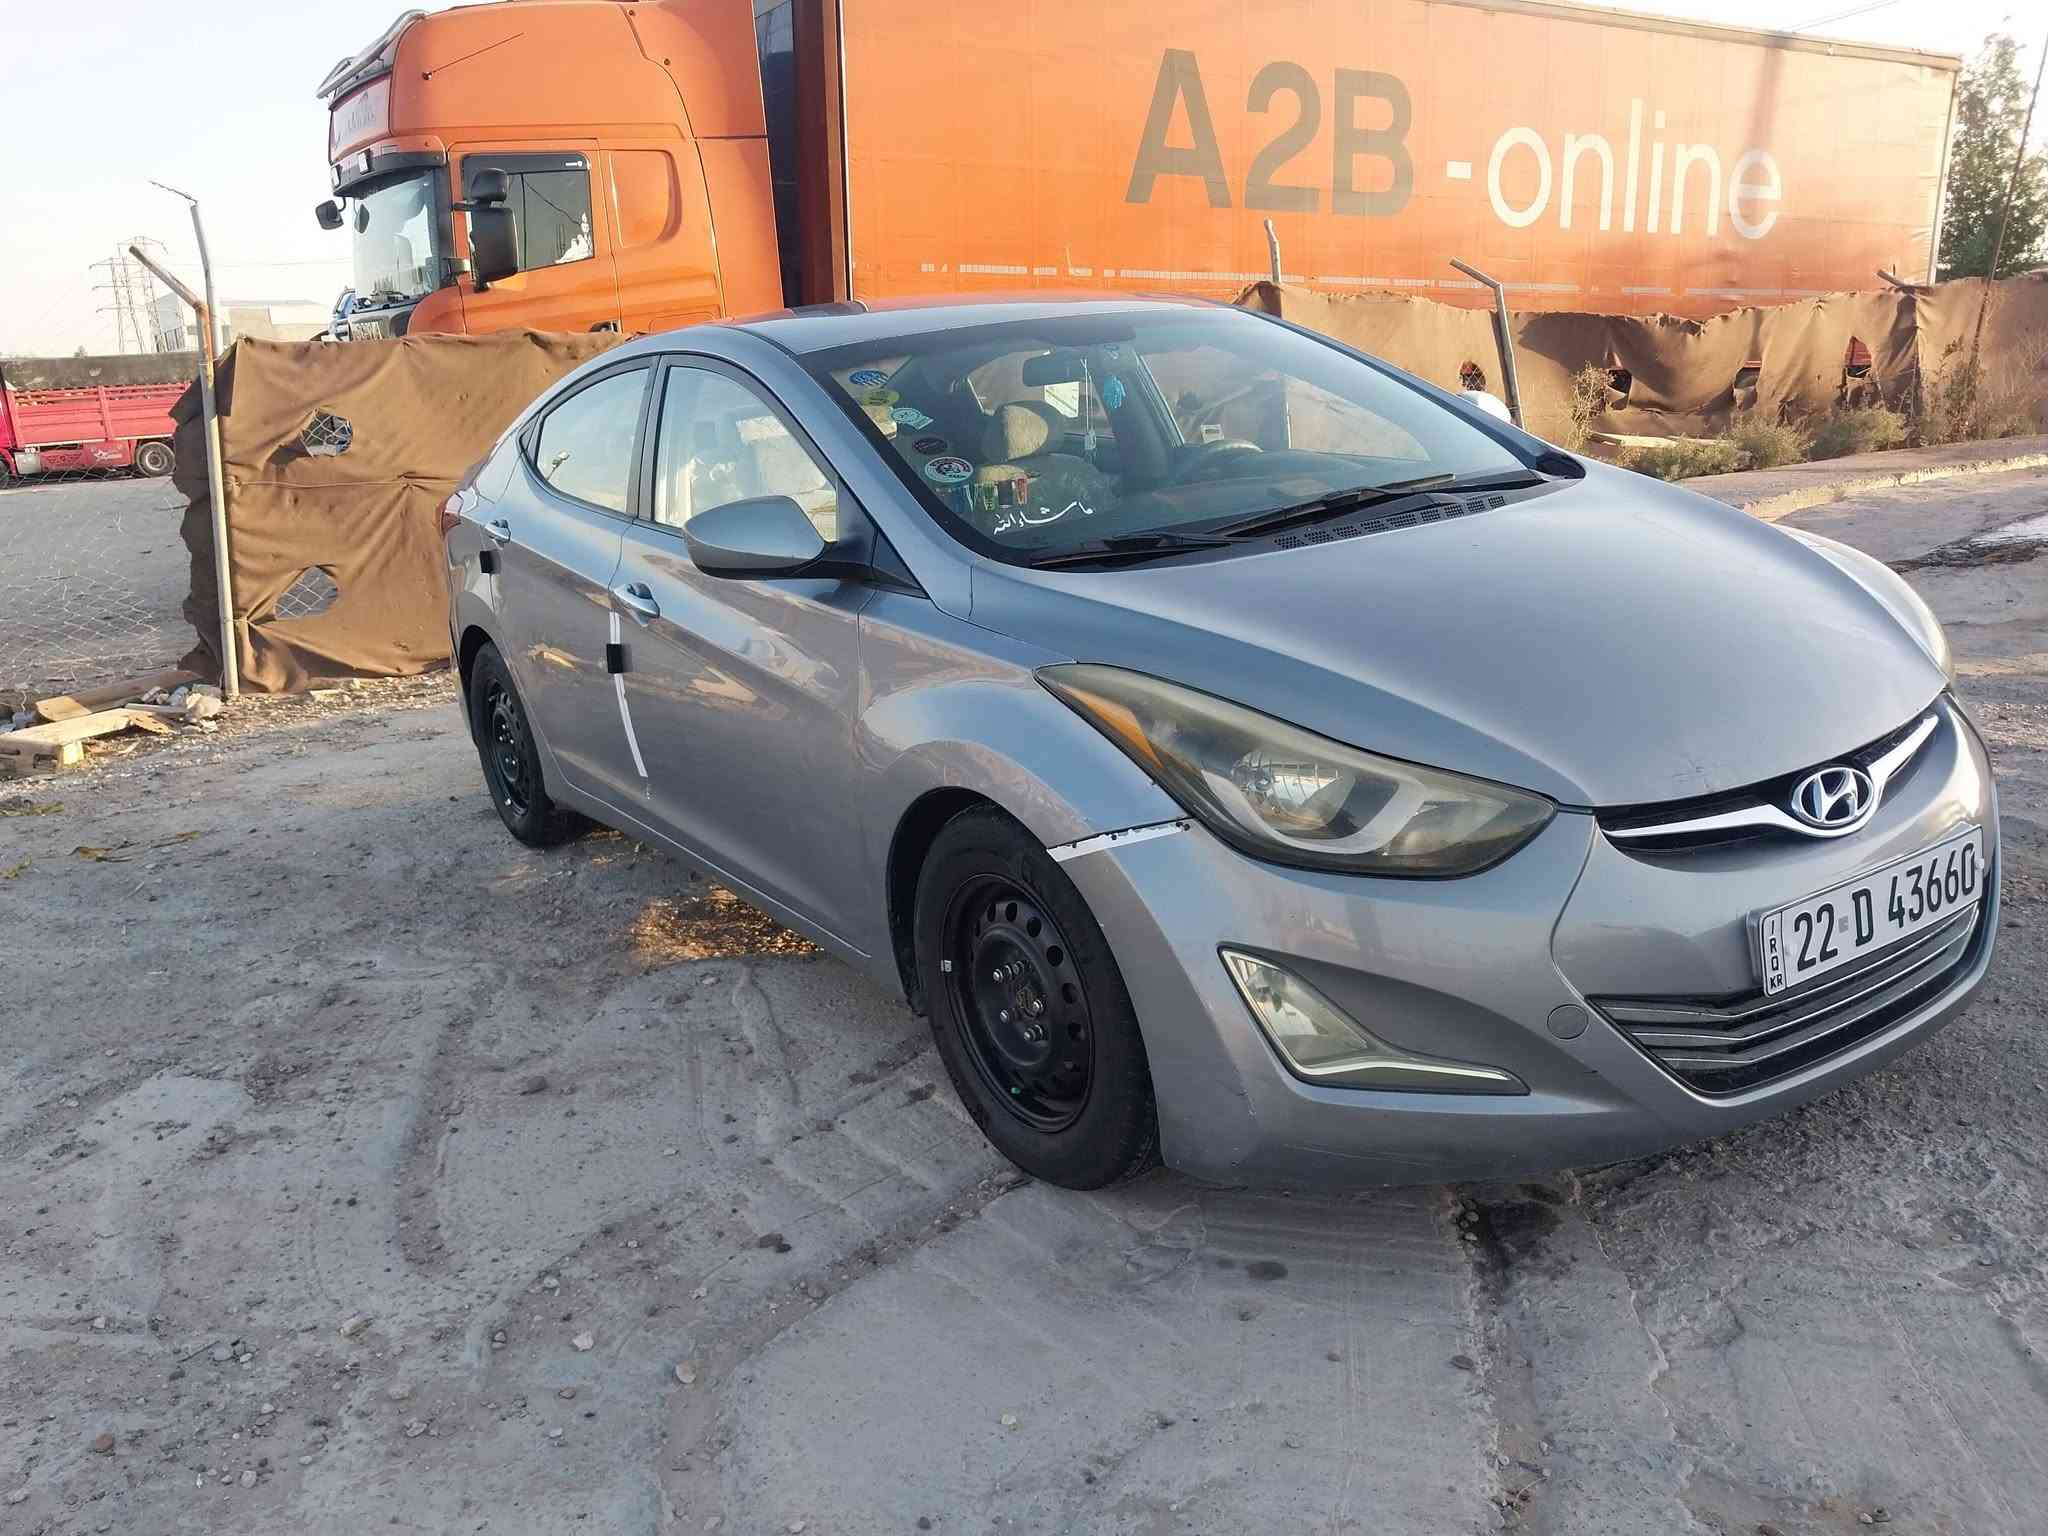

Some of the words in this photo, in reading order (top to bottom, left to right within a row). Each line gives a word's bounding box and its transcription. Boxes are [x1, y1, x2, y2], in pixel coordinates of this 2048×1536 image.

[1125, 48, 1414, 218] A2B
[1793, 902, 1839, 973] 22
[1851, 887, 1874, 948] D
[1887, 842, 1976, 929] 43660
